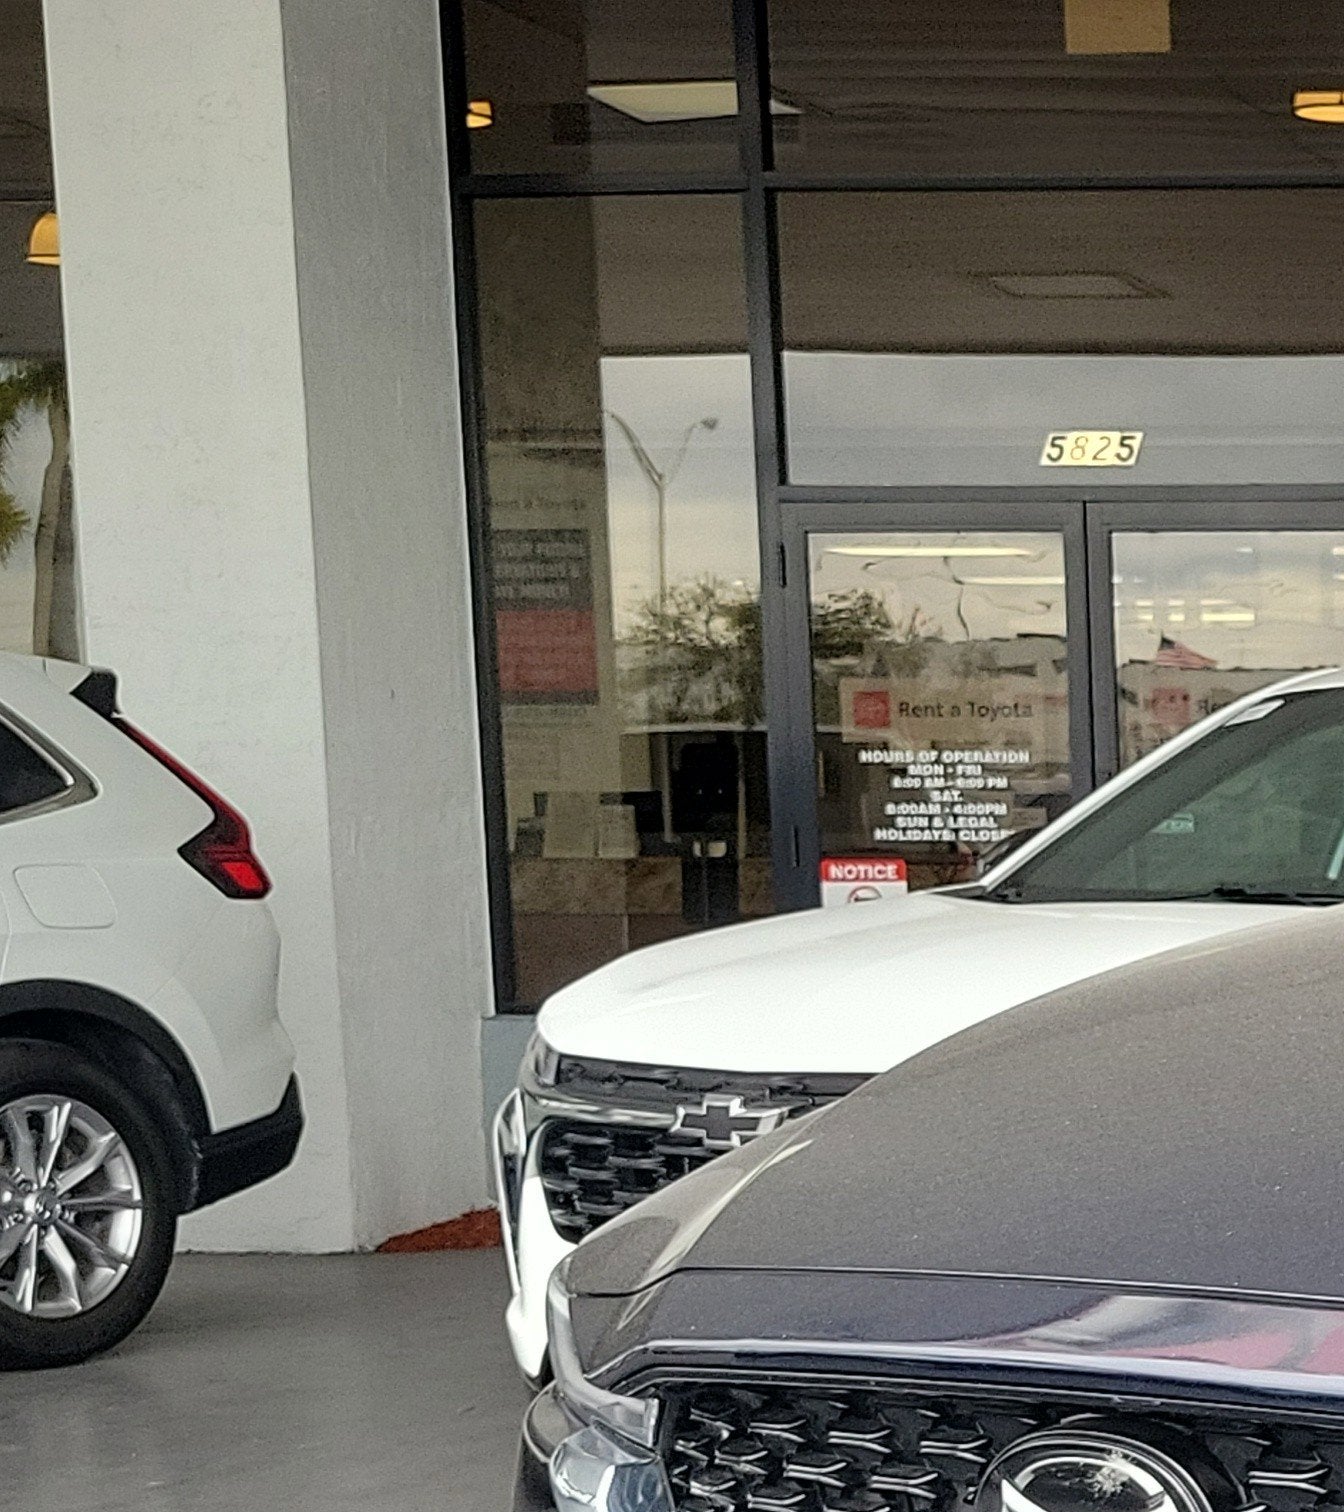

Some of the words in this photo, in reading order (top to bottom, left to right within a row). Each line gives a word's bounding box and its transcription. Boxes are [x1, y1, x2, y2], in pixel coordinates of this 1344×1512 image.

[1046, 435, 1138, 462] 5825
[899, 702, 944, 717] Rent
[952, 705, 961, 717] a
[967, 701, 1033, 722] Toyota
[859, 750, 915, 763] HOURS
[918, 750, 939, 763] OF
[941, 750, 1030, 763] OPERATION
[907, 764, 945, 775] MON
[955, 764, 983, 775] FRI
[986, 776, 1008, 788] PM
[895, 816, 929, 828] SUN
[946, 816, 999, 828] LEGAL
[828, 863, 899, 880] NOTICE
